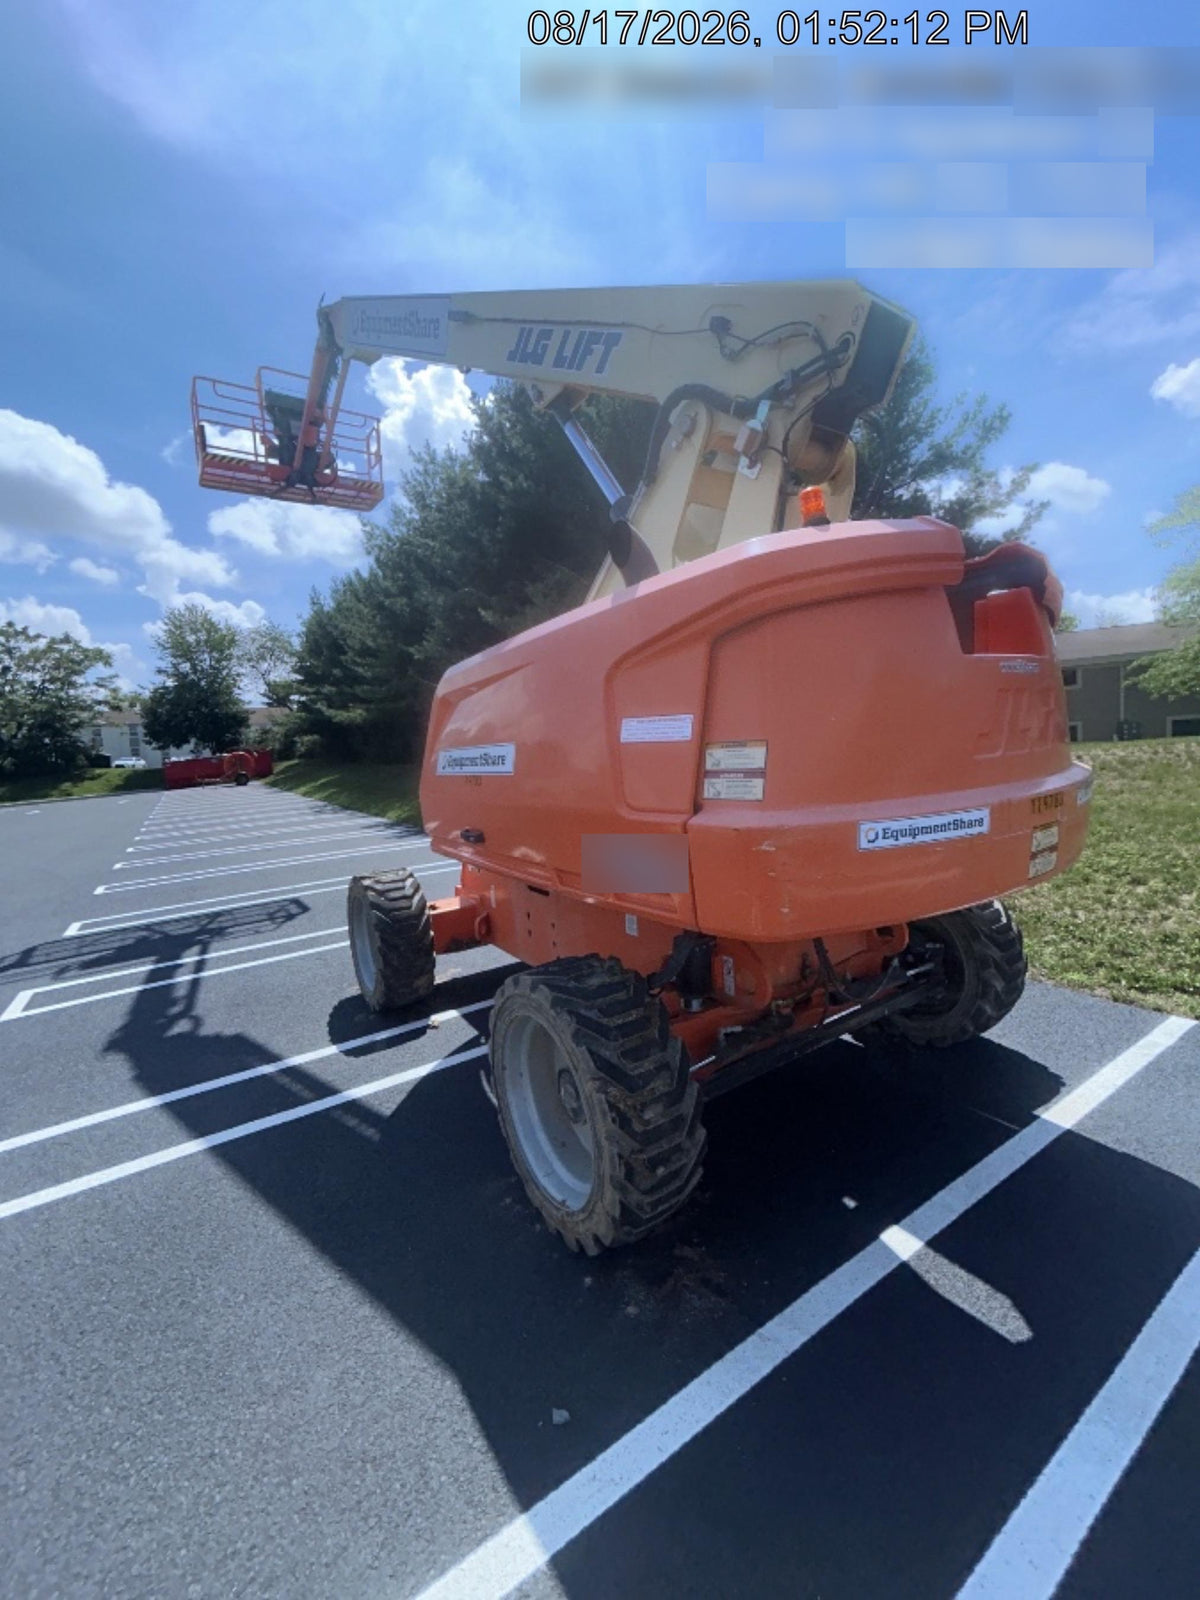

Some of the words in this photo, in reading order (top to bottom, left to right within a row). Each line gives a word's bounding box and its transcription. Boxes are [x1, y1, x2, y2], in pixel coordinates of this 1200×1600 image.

[505, 326, 554, 367] JLG
[551, 328, 624, 375] LIFT
[880, 816, 985, 841] EquipmentShare
